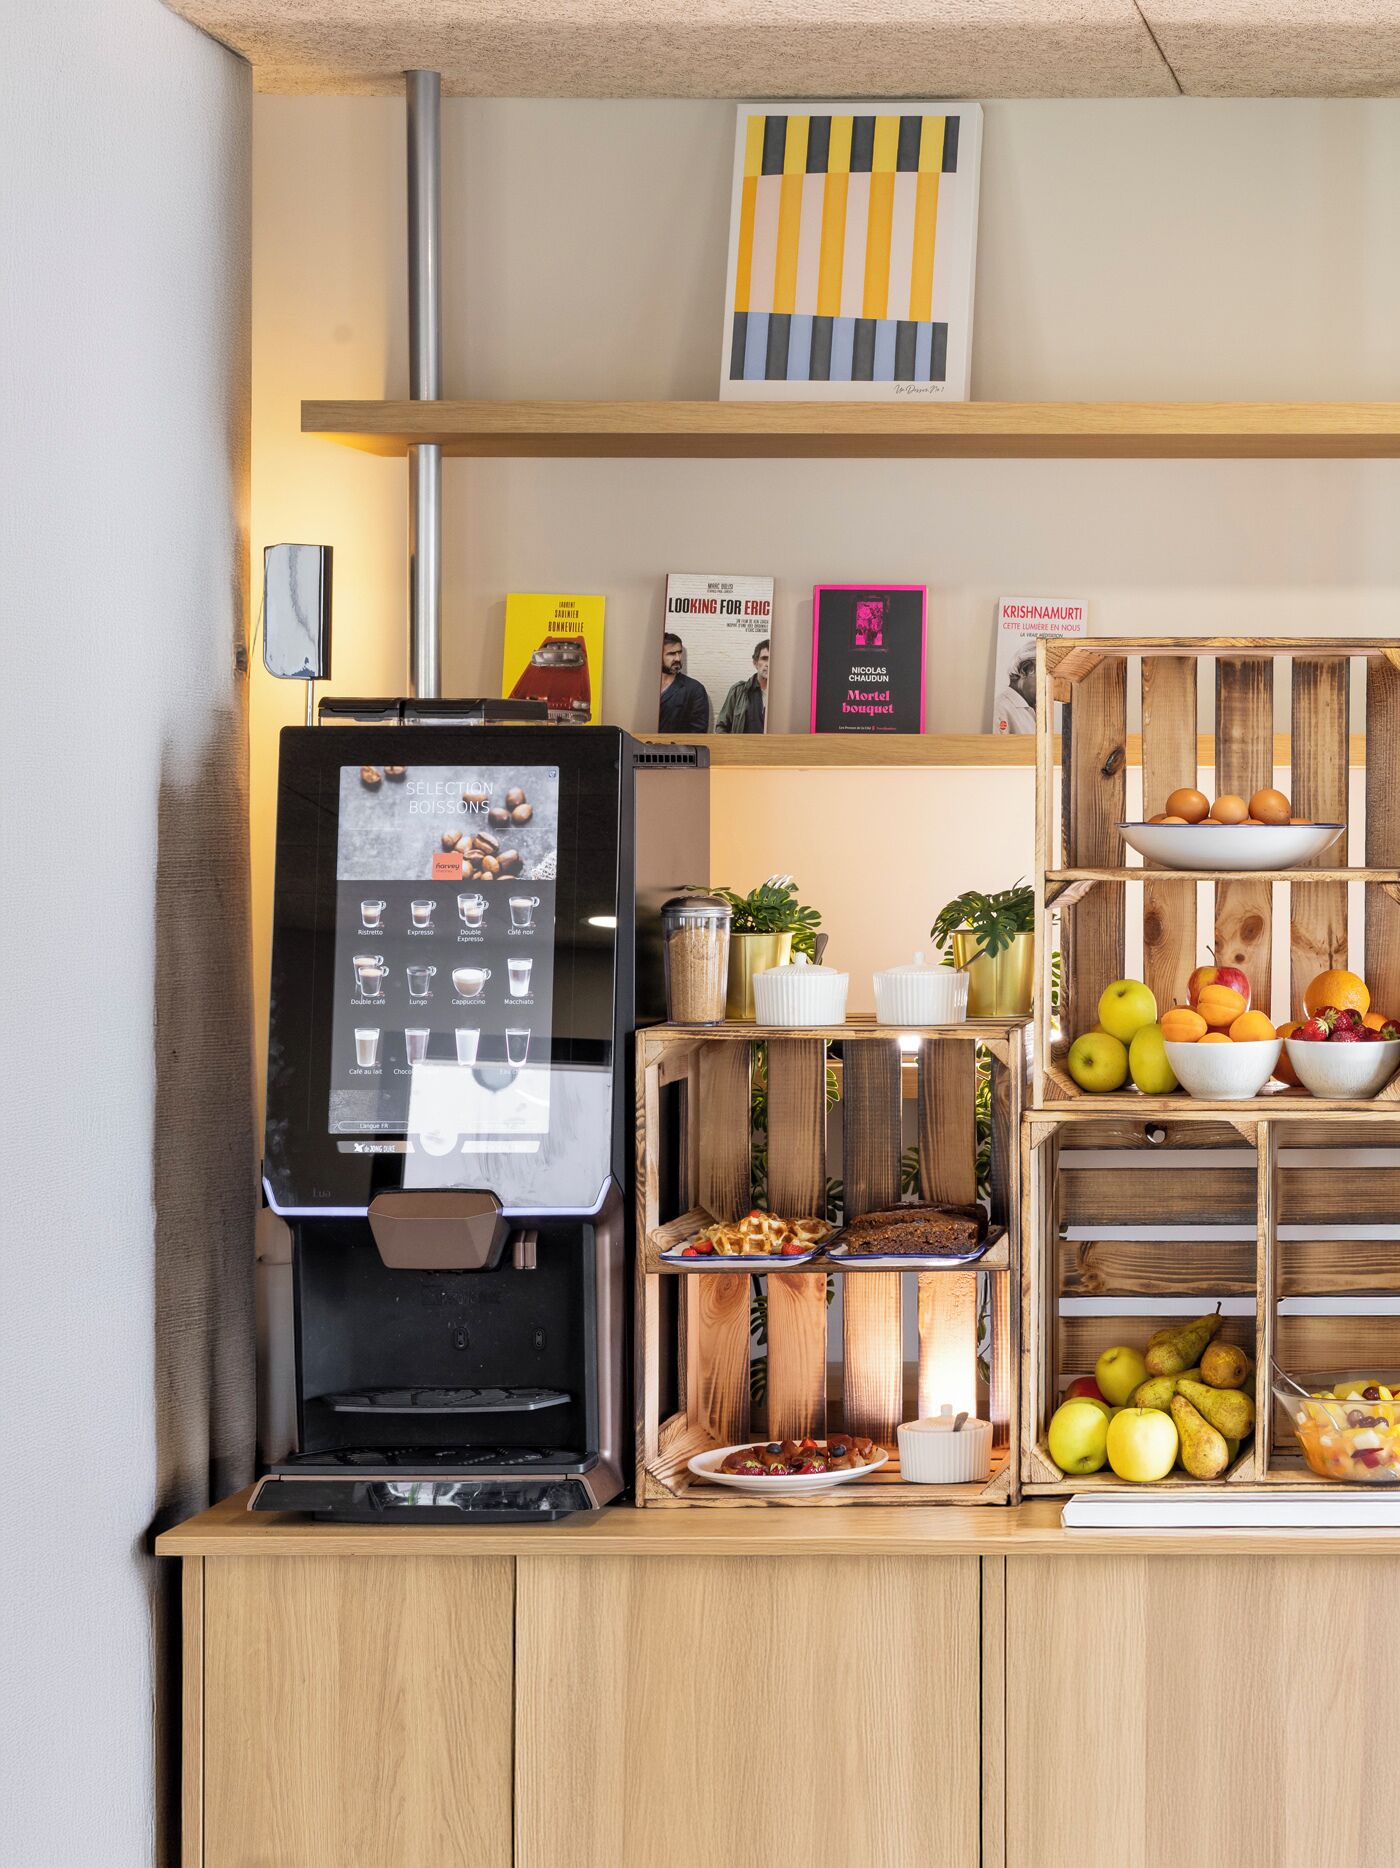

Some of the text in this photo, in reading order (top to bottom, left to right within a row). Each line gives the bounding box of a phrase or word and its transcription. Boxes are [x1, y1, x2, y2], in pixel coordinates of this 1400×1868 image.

[668, 598, 770, 616] LOOKING FOR ERIC
[1003, 605, 1083, 620] KRISHNAMURTI
[555, 610, 579, 618] SAULNIER
[548, 621, 584, 632] BONNEVILLE
[1003, 622, 1021, 630] CETTE
[851, 666, 887, 674] NICOLAS
[848, 674, 889, 682] CHAUDUN
[847, 690, 890, 701] Mortel
[842, 702, 894, 716] bouquet
[409, 800, 490, 814] BOISSONS
